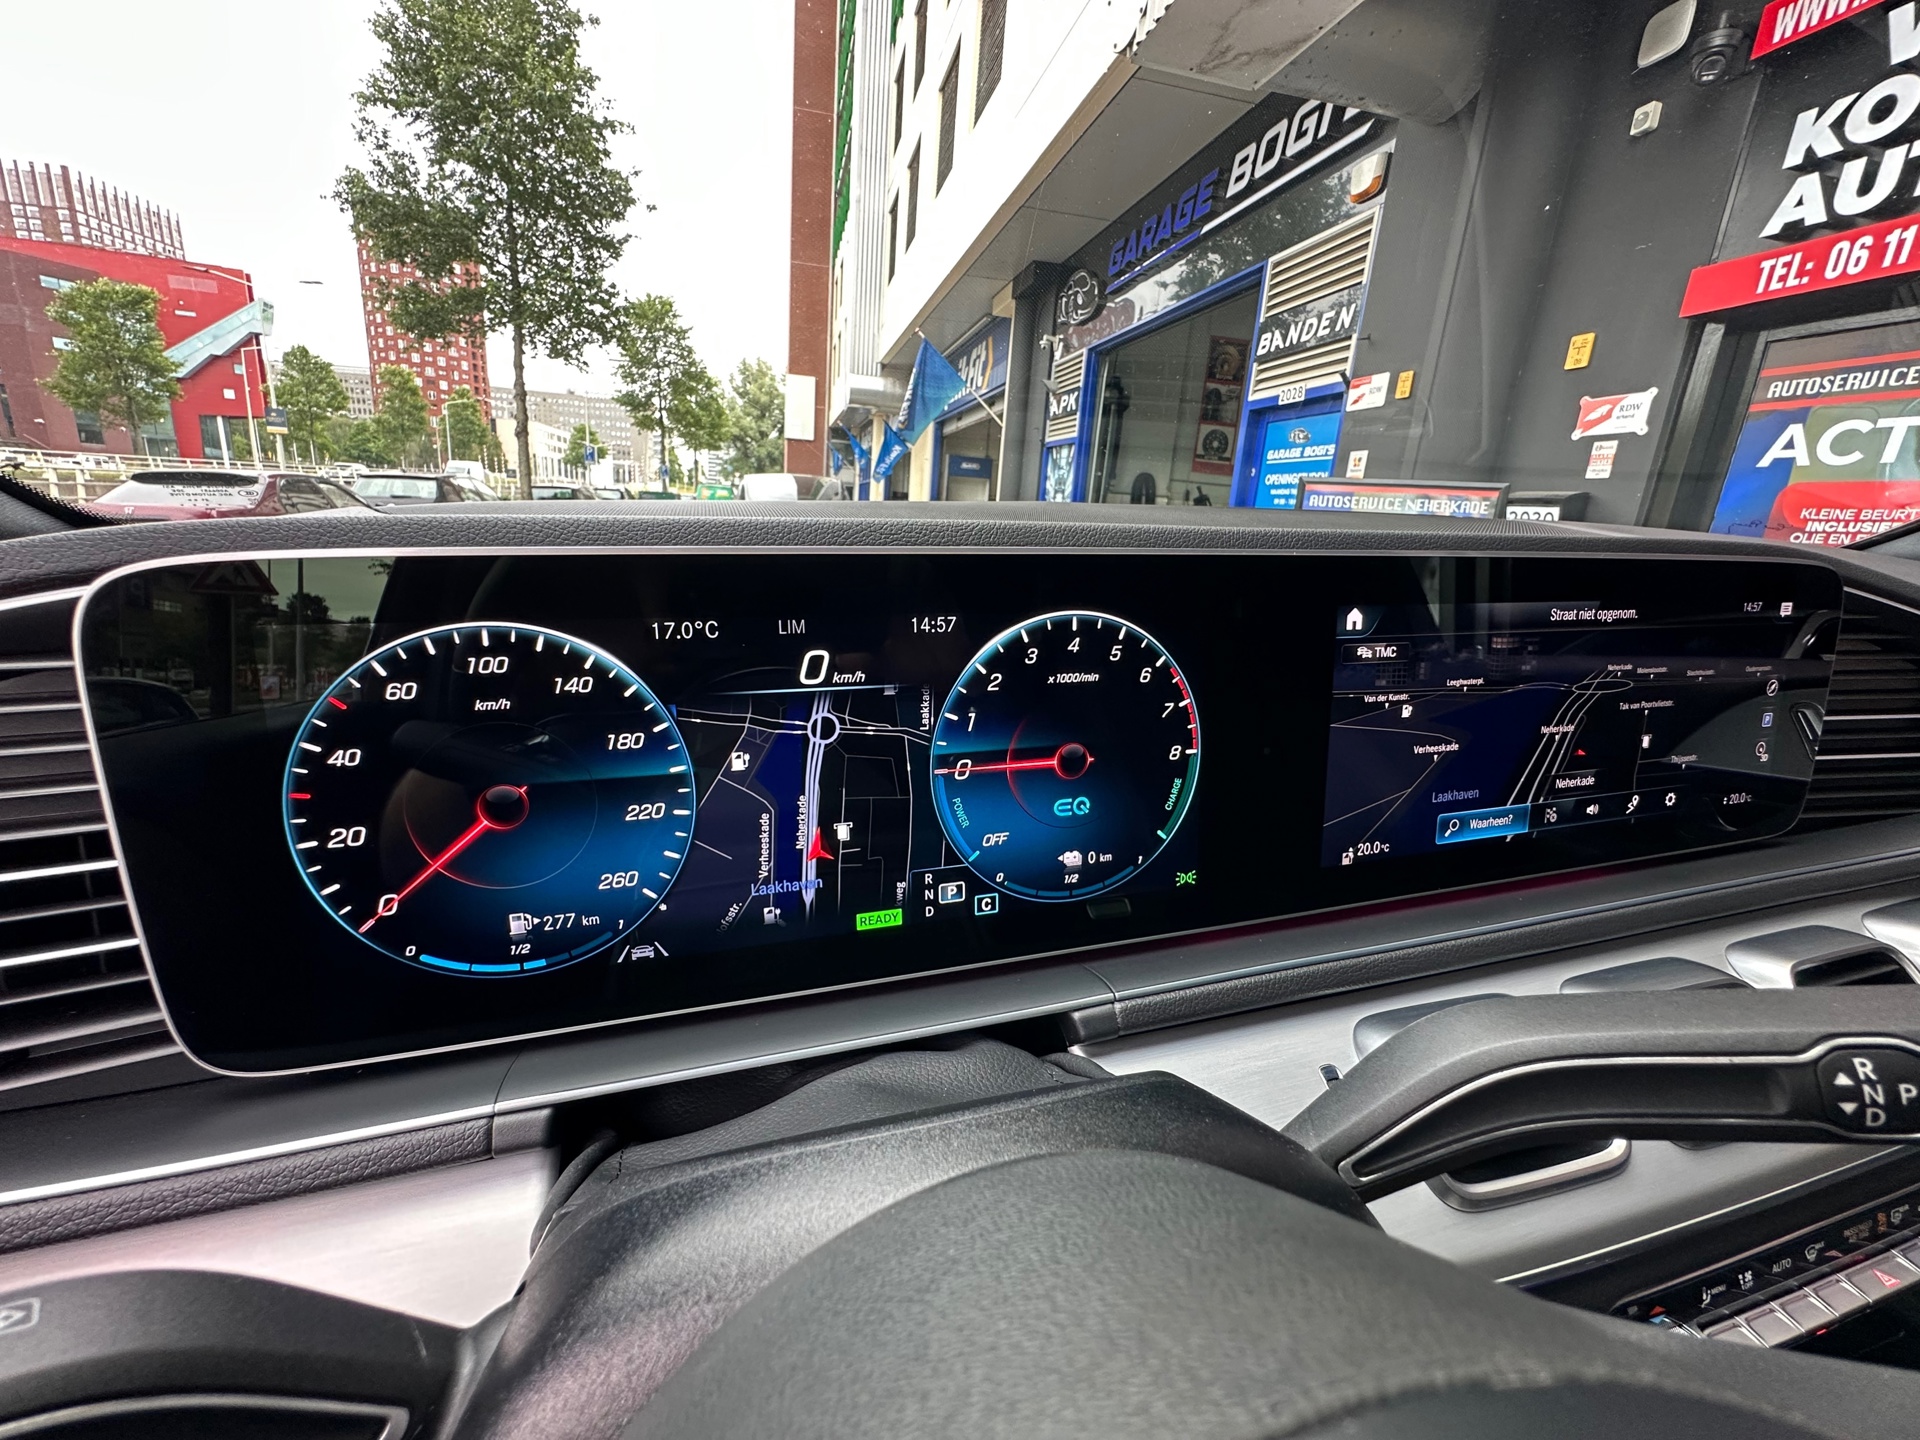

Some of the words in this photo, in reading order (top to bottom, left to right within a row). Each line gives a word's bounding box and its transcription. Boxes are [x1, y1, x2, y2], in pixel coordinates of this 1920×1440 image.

[1758, 140, 1920, 238] AU
[1107, 167, 1219, 277] GARAGE
[1756, 252, 1815, 294] TEL:
[1824, 235, 1873, 280] 06
[1881, 224, 1919, 268] 11
[1255, 303, 1357, 358] BANDEN
[1767, 366, 1920, 399] AUTOSERVICE
[1279, 386, 1304, 402] 2028
[1049, 391, 1079, 417] APK
[1619, 402, 1643, 413] RDW
[1755, 416, 1920, 468] ACT
[1266, 447, 1303, 461] GARAGE
[1303, 444, 1337, 457] BOGI'S
[1309, 495, 1402, 511] AUTOSERVICE
[1405, 499, 1490, 515] NEHERKADE
[1800, 508, 1857, 520] KLEINE
[1859, 508, 1920, 521] BEURT
[1790, 532, 1826, 544] OLIE
[1827, 533, 1852, 545] EN
[1550, 608, 1577, 621] Straat
[1578, 607, 1596, 620] niet
[1597, 608, 1638, 622] opgenom.
[1743, 602, 1763, 612] 14:57
[651, 620, 719, 640] 17.0°C
[778, 620, 806, 635] LIM
[911, 616, 957, 633] 14:57
[1067, 638, 1080, 653] 4
[1109, 645, 1122, 661] 5
[1375, 646, 1397, 658] TMC
[1025, 648, 1038, 664] 3
[466, 656, 509, 675] 100
[799, 649, 830, 685] 0
[832, 670, 866, 684] km/h
[987, 674, 1002, 691] 2
[1047, 672, 1099, 684] x1000/min
[1139, 667, 1151, 683] 6
[385, 682, 418, 701] 60
[554, 676, 594, 695] 140
[474, 699, 511, 711] km/h
[1364, 695, 1377, 703] Van
[1378, 694, 1388, 702] der
[1388, 693, 1411, 701] Kunstr.
[1619, 702, 1630, 710] Tak
[1631, 702, 1640, 710] van
[920, 683, 931, 731] Laakkade
[1161, 702, 1174, 718] 7
[967, 712, 976, 731] 1
[1540, 724, 1575, 734] Neherkade
[606, 733, 645, 750] 180
[1413, 743, 1459, 754] Verheeskade
[327, 749, 362, 768] 40
[1168, 745, 1181, 761] 8
[954, 759, 972, 780] 0
[1555, 776, 1595, 789] Neherkade
[1164, 777, 1182, 811] CHARGE
[1431, 788, 1480, 803] Laakhaven
[625, 803, 666, 821] 220
[952, 797, 970, 828] POWER
[795, 794, 807, 850] Neherkade
[1469, 814, 1513, 830] Waarheen?
[327, 826, 366, 848] 20
[982, 832, 1010, 847] OFF
[758, 812, 770, 879] Verheeskade
[1087, 851, 1096, 864] 0
[1099, 852, 1112, 862] km
[1137, 856, 1143, 864] 1
[598, 871, 639, 889] 260
[924, 873, 933, 884] R
[996, 873, 1004, 882] 0
[1063, 873, 1079, 883] 1/2
[750, 876, 823, 896] Laakhaven
[947, 886, 957, 899] P
[924, 889, 934, 900] N
[378, 894, 399, 916] 0
[925, 906, 935, 917] D
[981, 898, 992, 911] C
[543, 913, 576, 931] 277
[582, 915, 600, 926] km
[617, 919, 624, 930] 1
[859, 912, 900, 926] READY
[405, 945, 416, 957] 0
[510, 943, 531, 955] 1/2
[1852, 1057, 1877, 1080] R
[1862, 1084, 1885, 1106] N
[1898, 1084, 1917, 1105] P
[1865, 1107, 1886, 1127] D
[1772, 1258, 1792, 1274] AUTO
[1711, 1284, 1727, 1295] MENU
